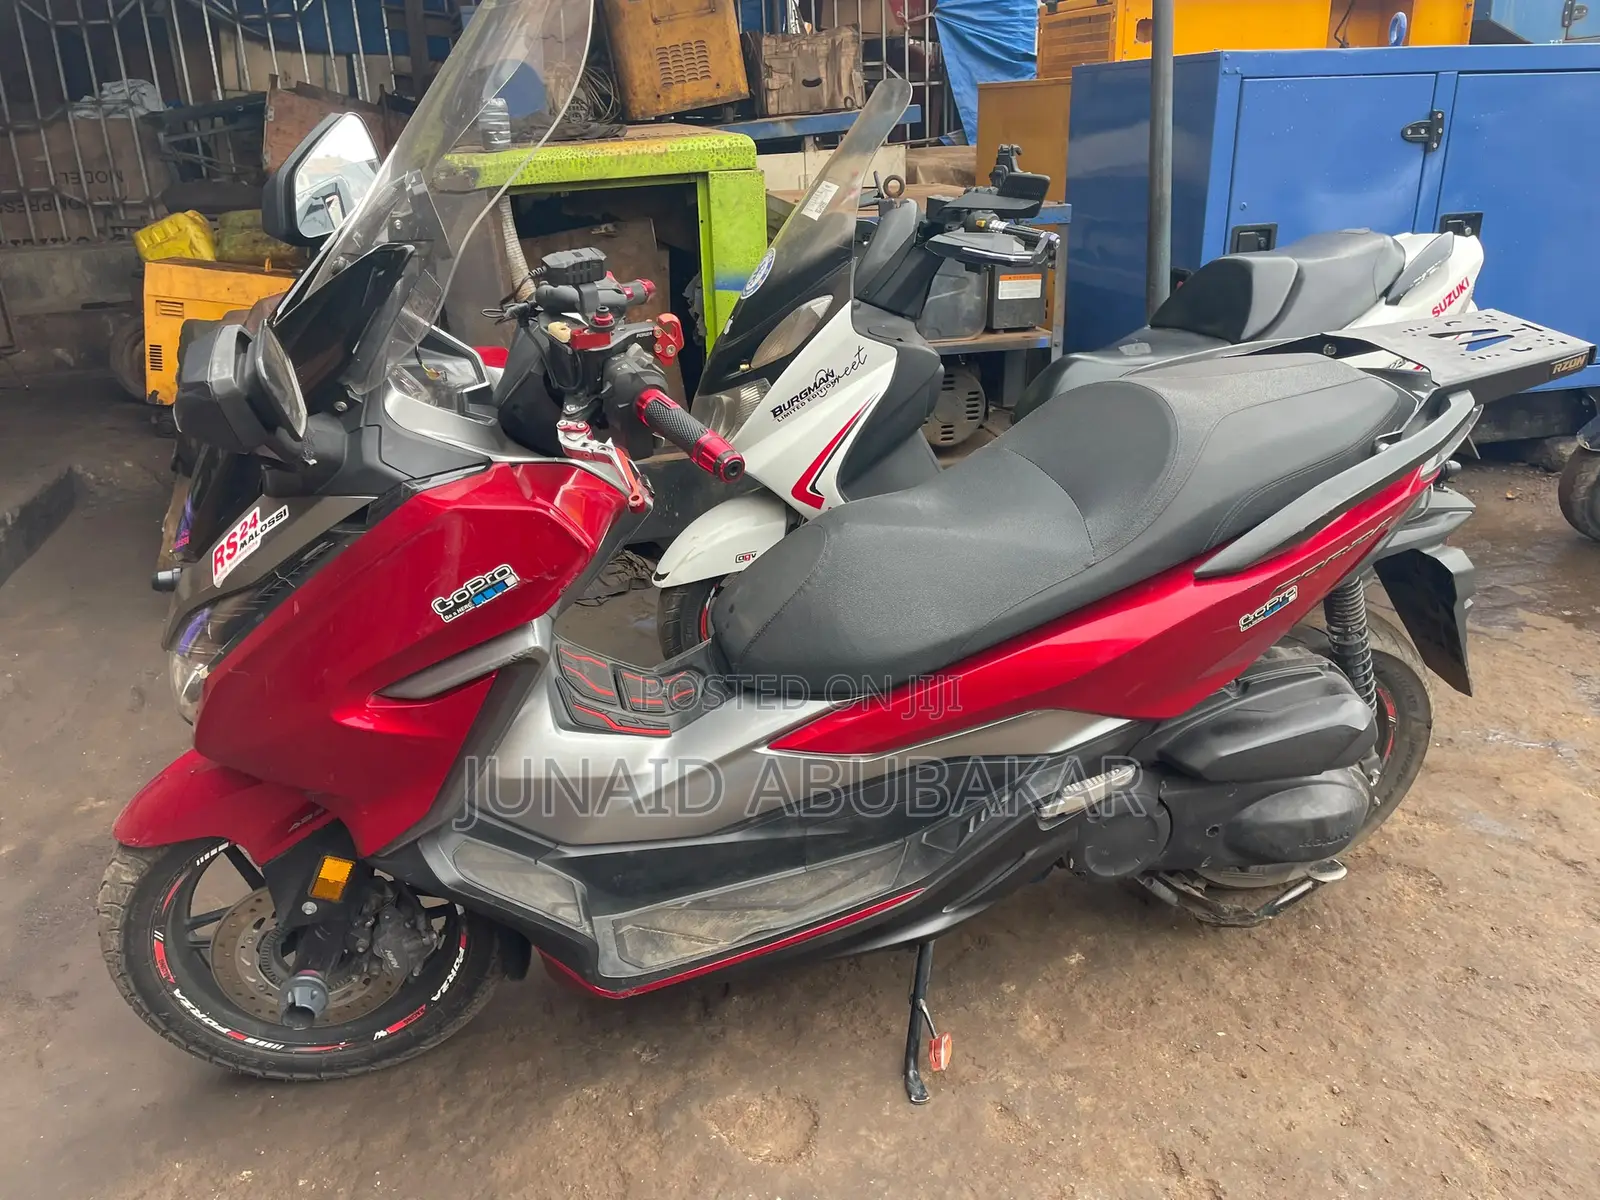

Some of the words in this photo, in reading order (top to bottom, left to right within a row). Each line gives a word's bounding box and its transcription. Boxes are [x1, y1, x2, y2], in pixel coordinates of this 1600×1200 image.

[1431, 275, 1470, 318] SUZUKI
[770, 368, 835, 419] BURGMAN
[776, 402, 806, 423] LIMITED
[239, 508, 288, 551] MALOSSI
[433, 565, 512, 613] GoPro
[1240, 586, 1297, 627] GoPro
[430, 946, 466, 1002] FORZA
[173, 987, 232, 1034] FORZA
